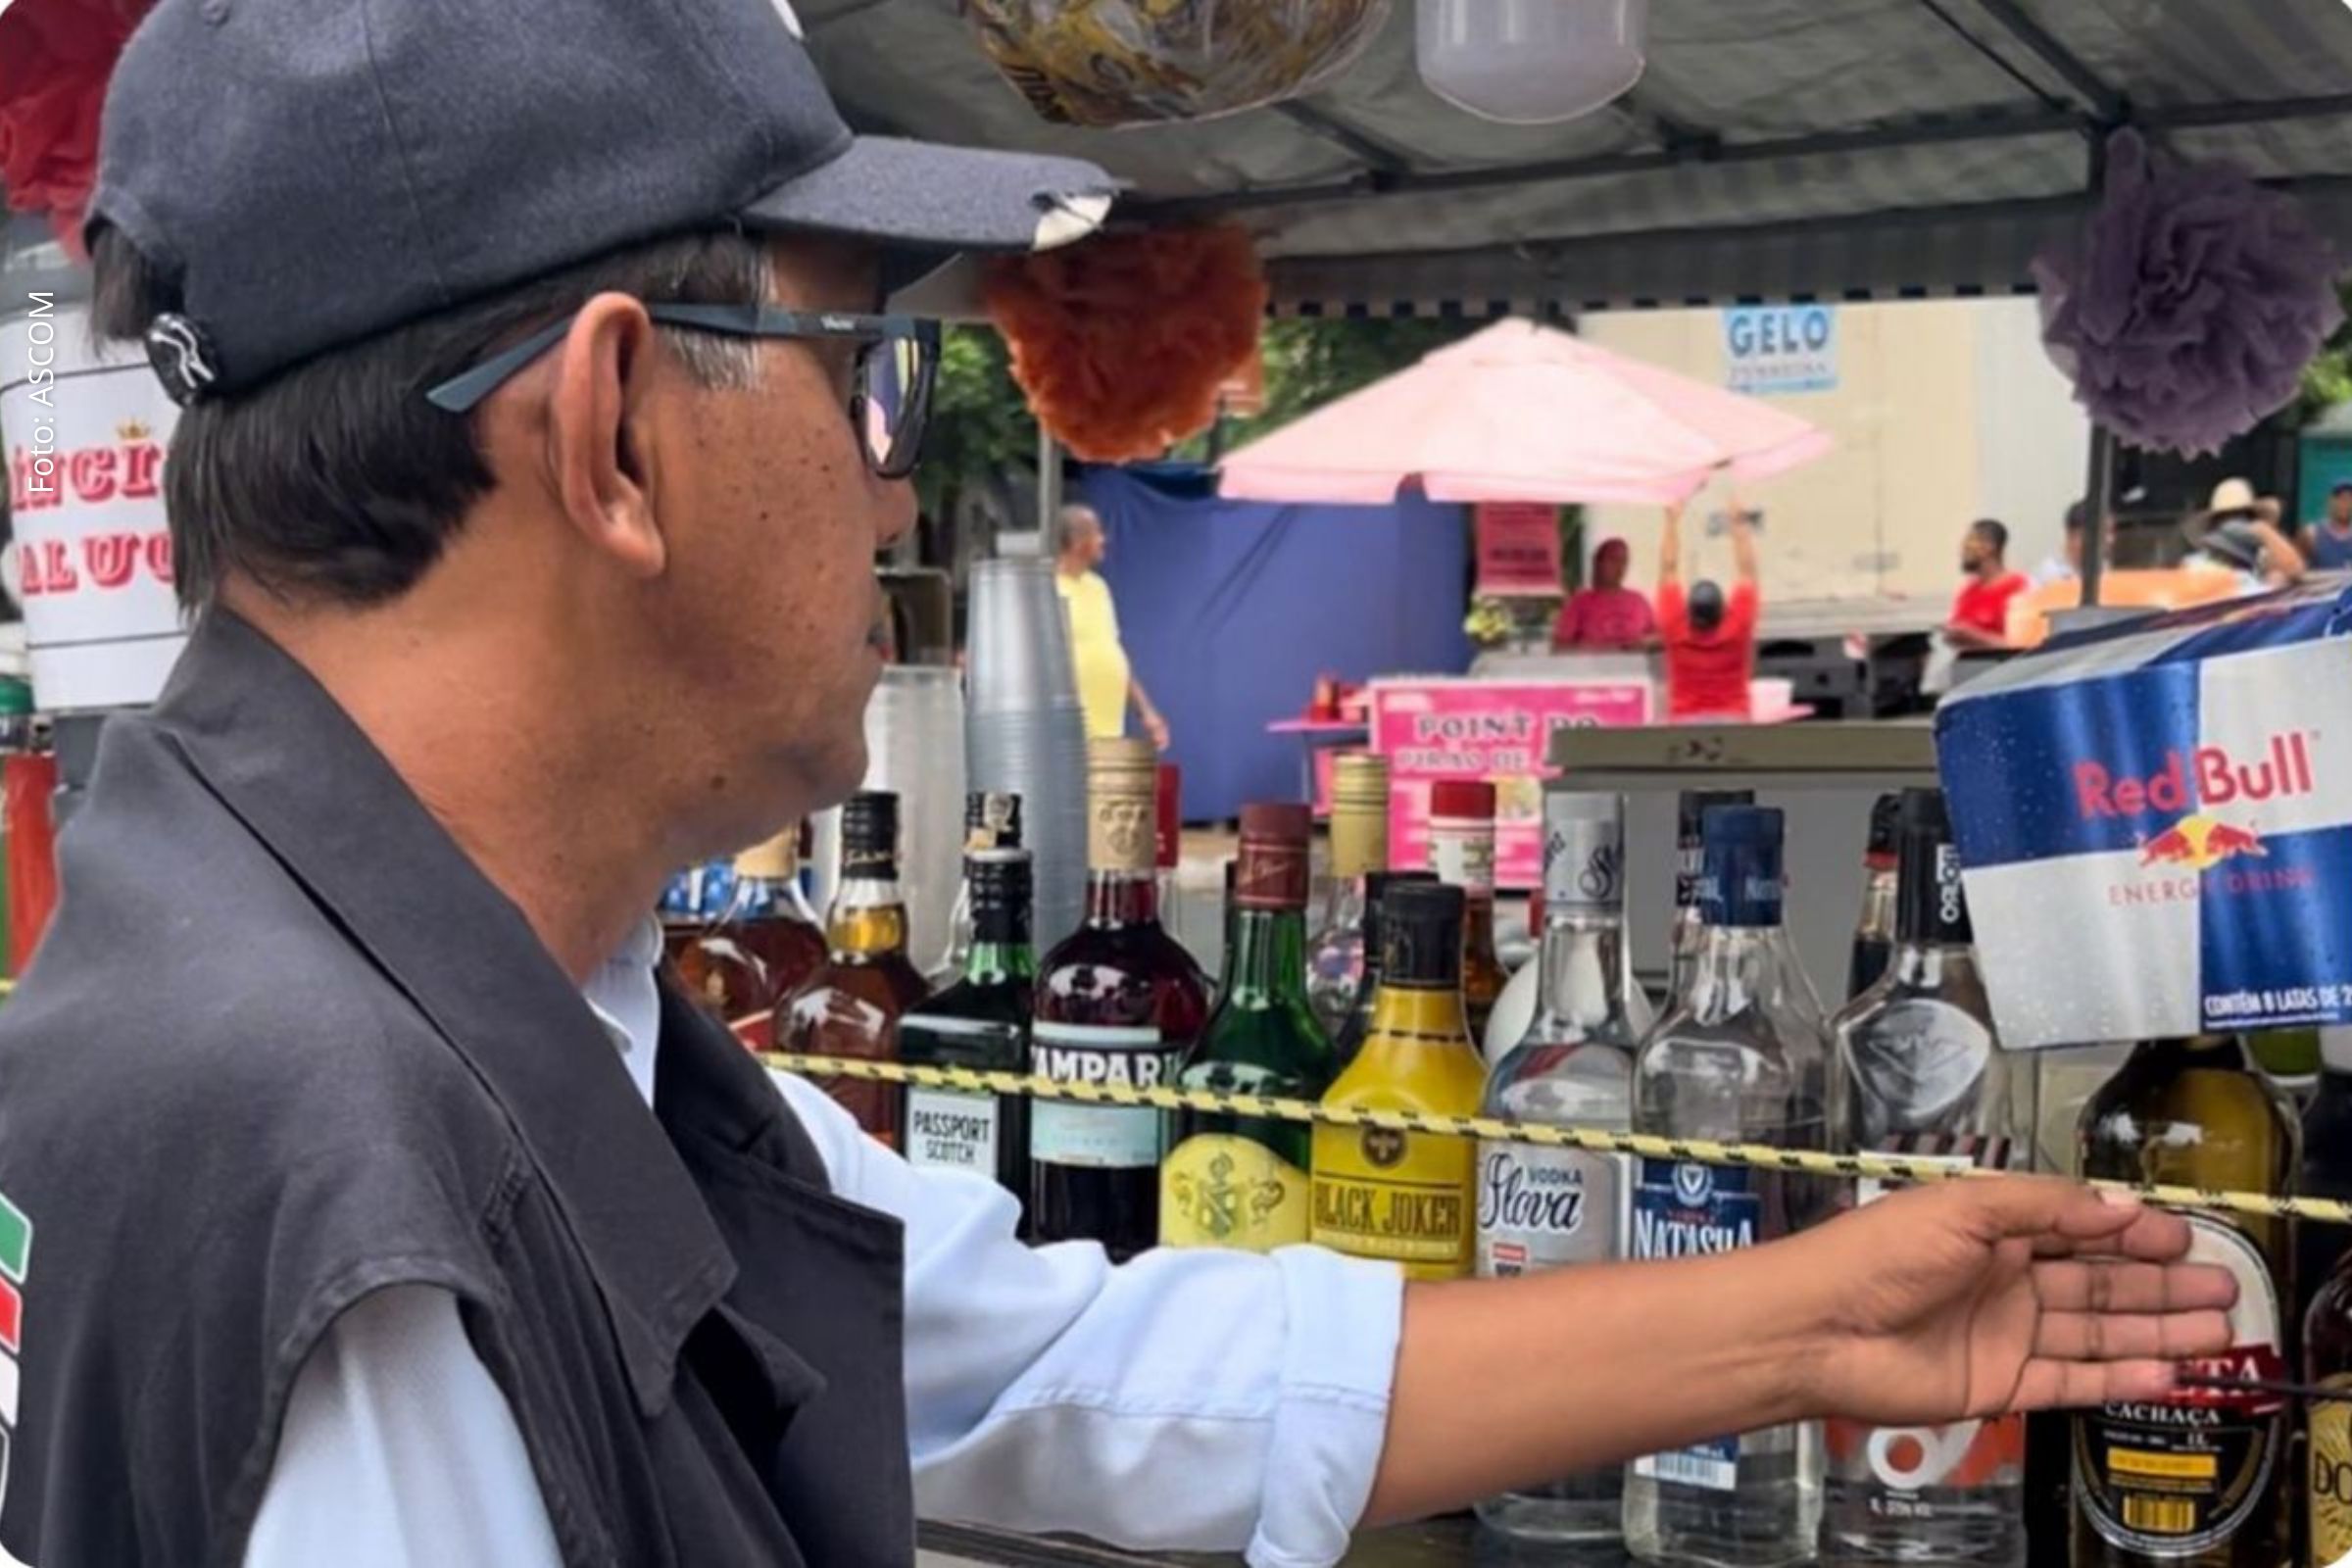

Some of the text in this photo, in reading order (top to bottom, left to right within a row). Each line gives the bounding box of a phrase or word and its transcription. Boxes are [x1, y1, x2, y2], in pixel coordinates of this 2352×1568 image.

[1729, 311, 1829, 358] GELO
[1420, 712, 1531, 738] POINT
[2072, 731, 2313, 819] Red Bull
[913, 1110, 991, 1142] PASSPORT
[926, 1140, 974, 1164] SCOTCH
[1482, 1152, 1583, 1231] Slova
[1527, 1166, 1583, 1186] VODKA
[1313, 1183, 1461, 1236] BLACK JOKER
[2105, 1402, 2221, 1427] CACHAÇA
